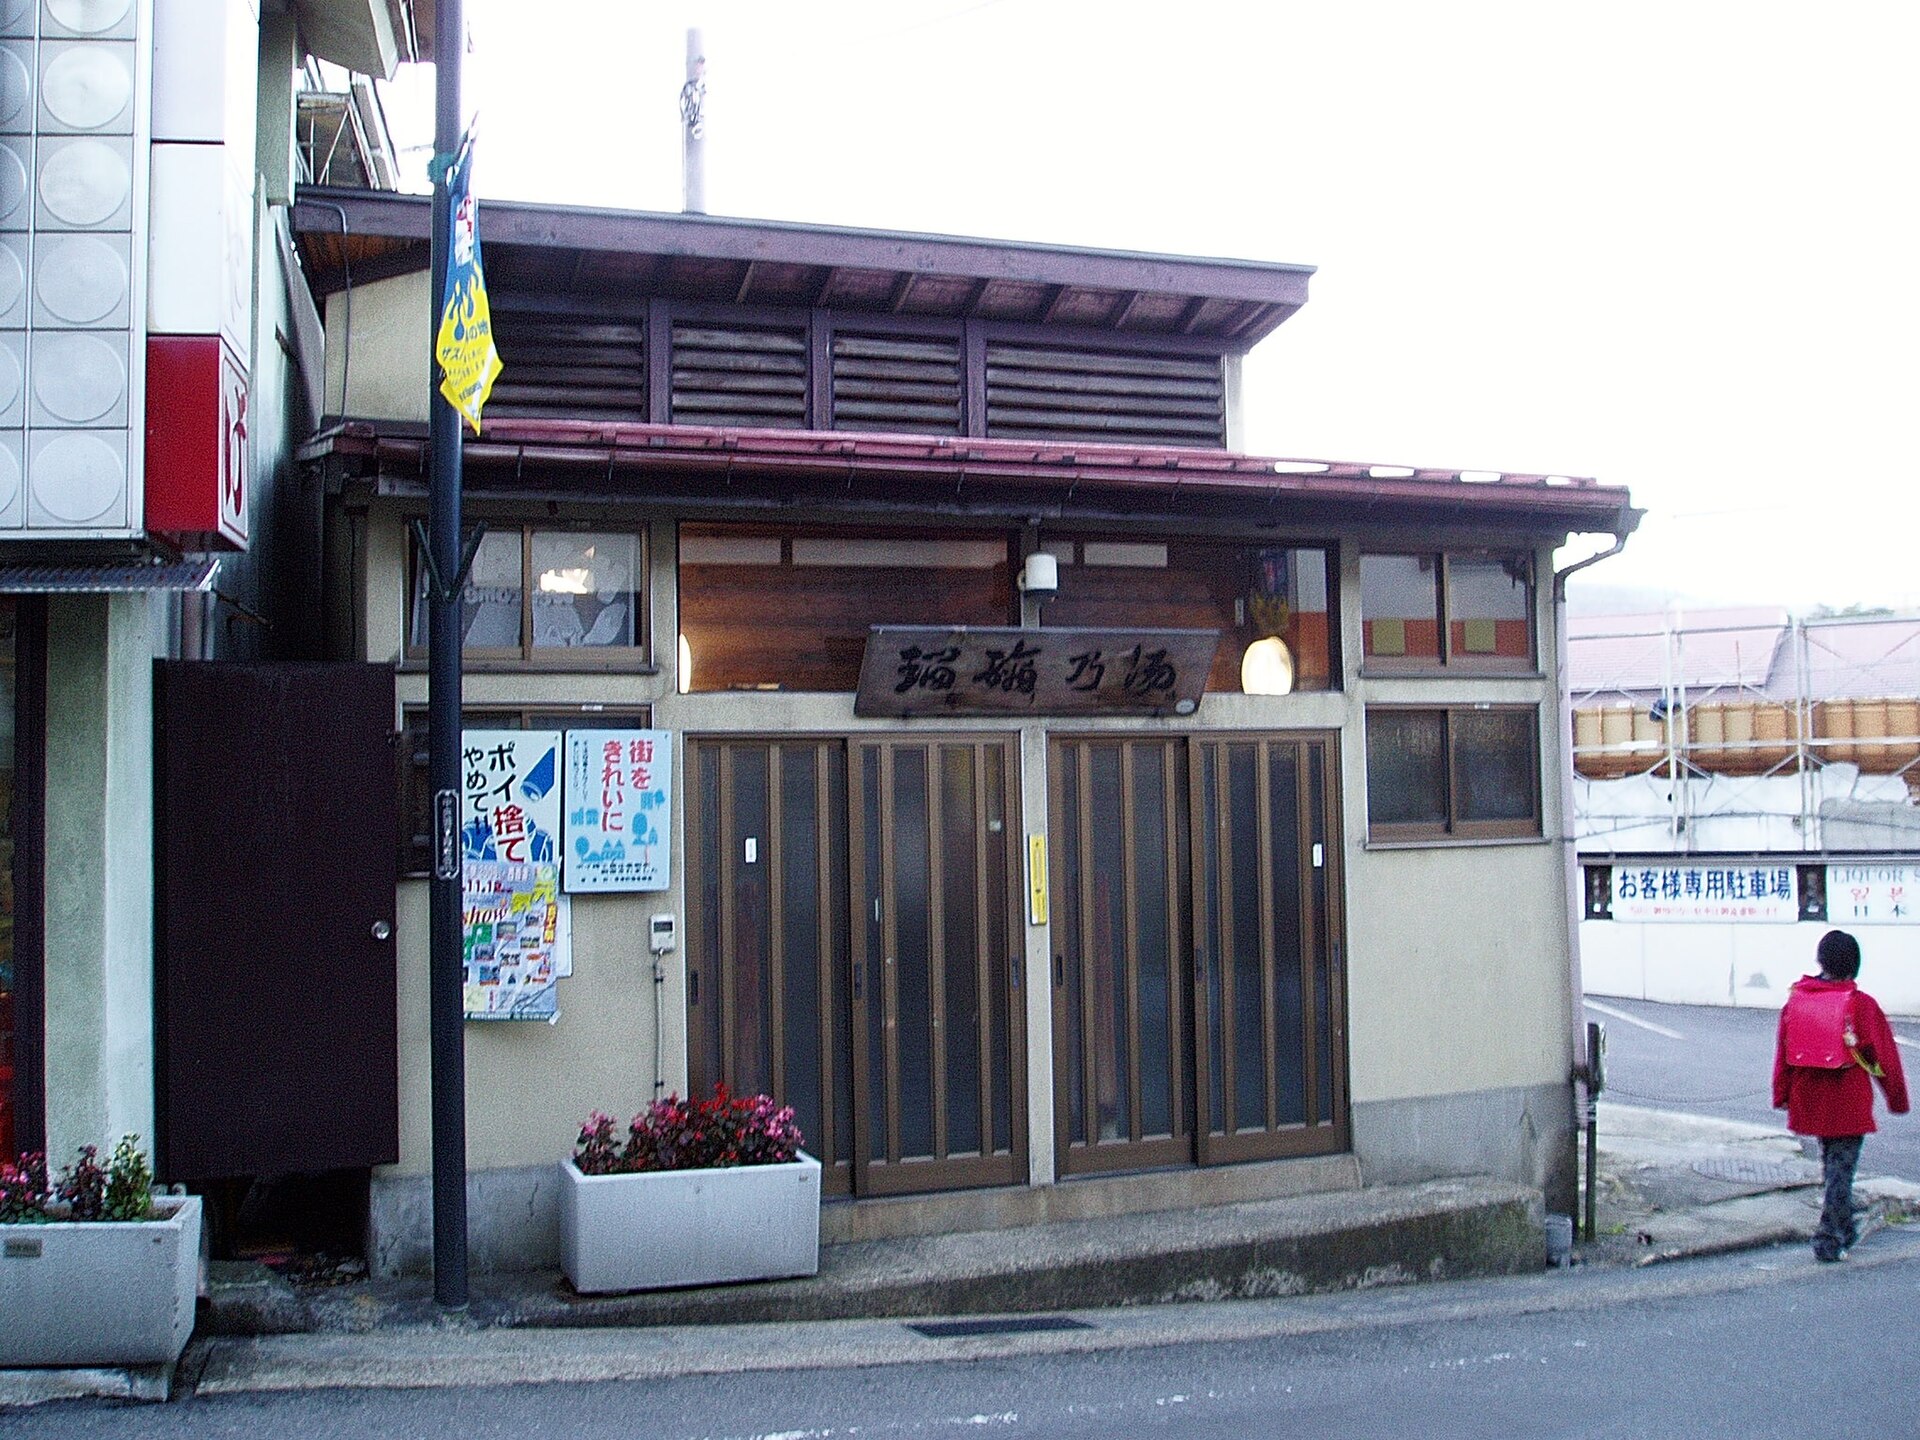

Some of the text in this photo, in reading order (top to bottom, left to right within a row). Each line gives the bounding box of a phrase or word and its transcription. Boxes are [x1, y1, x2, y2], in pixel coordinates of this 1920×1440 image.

[601, 738, 624, 832] きれいに
[629, 738, 654, 791] 街を
[488, 740, 526, 863] ポイ捨て
[1618, 868, 1792, 901] お客様専用駐車場
